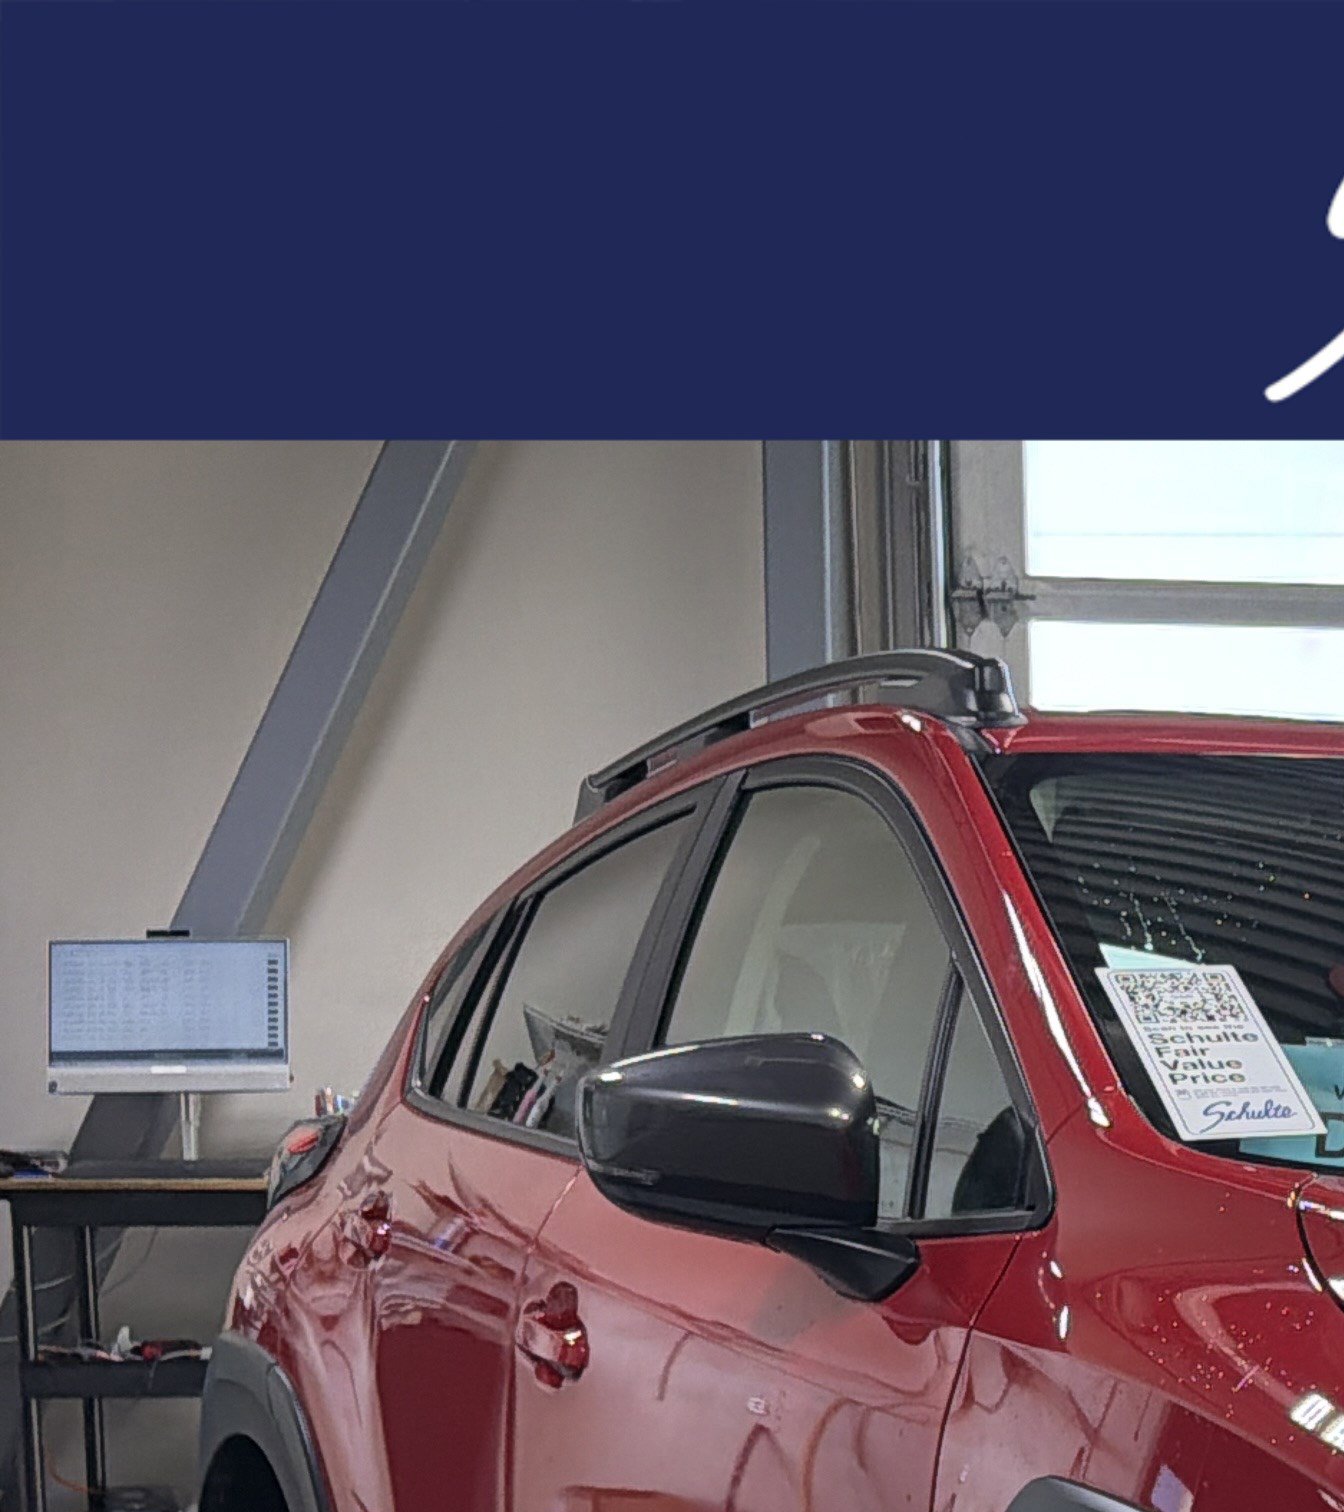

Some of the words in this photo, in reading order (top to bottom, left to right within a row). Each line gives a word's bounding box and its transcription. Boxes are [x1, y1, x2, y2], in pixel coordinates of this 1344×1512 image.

[1148, 1031, 1259, 1045] Schulte
[1155, 1045, 1211, 1058] Fair
[1160, 1058, 1243, 1071] Value
[1168, 1072, 1246, 1085] Price
[1200, 1099, 1298, 1134] Schulte
